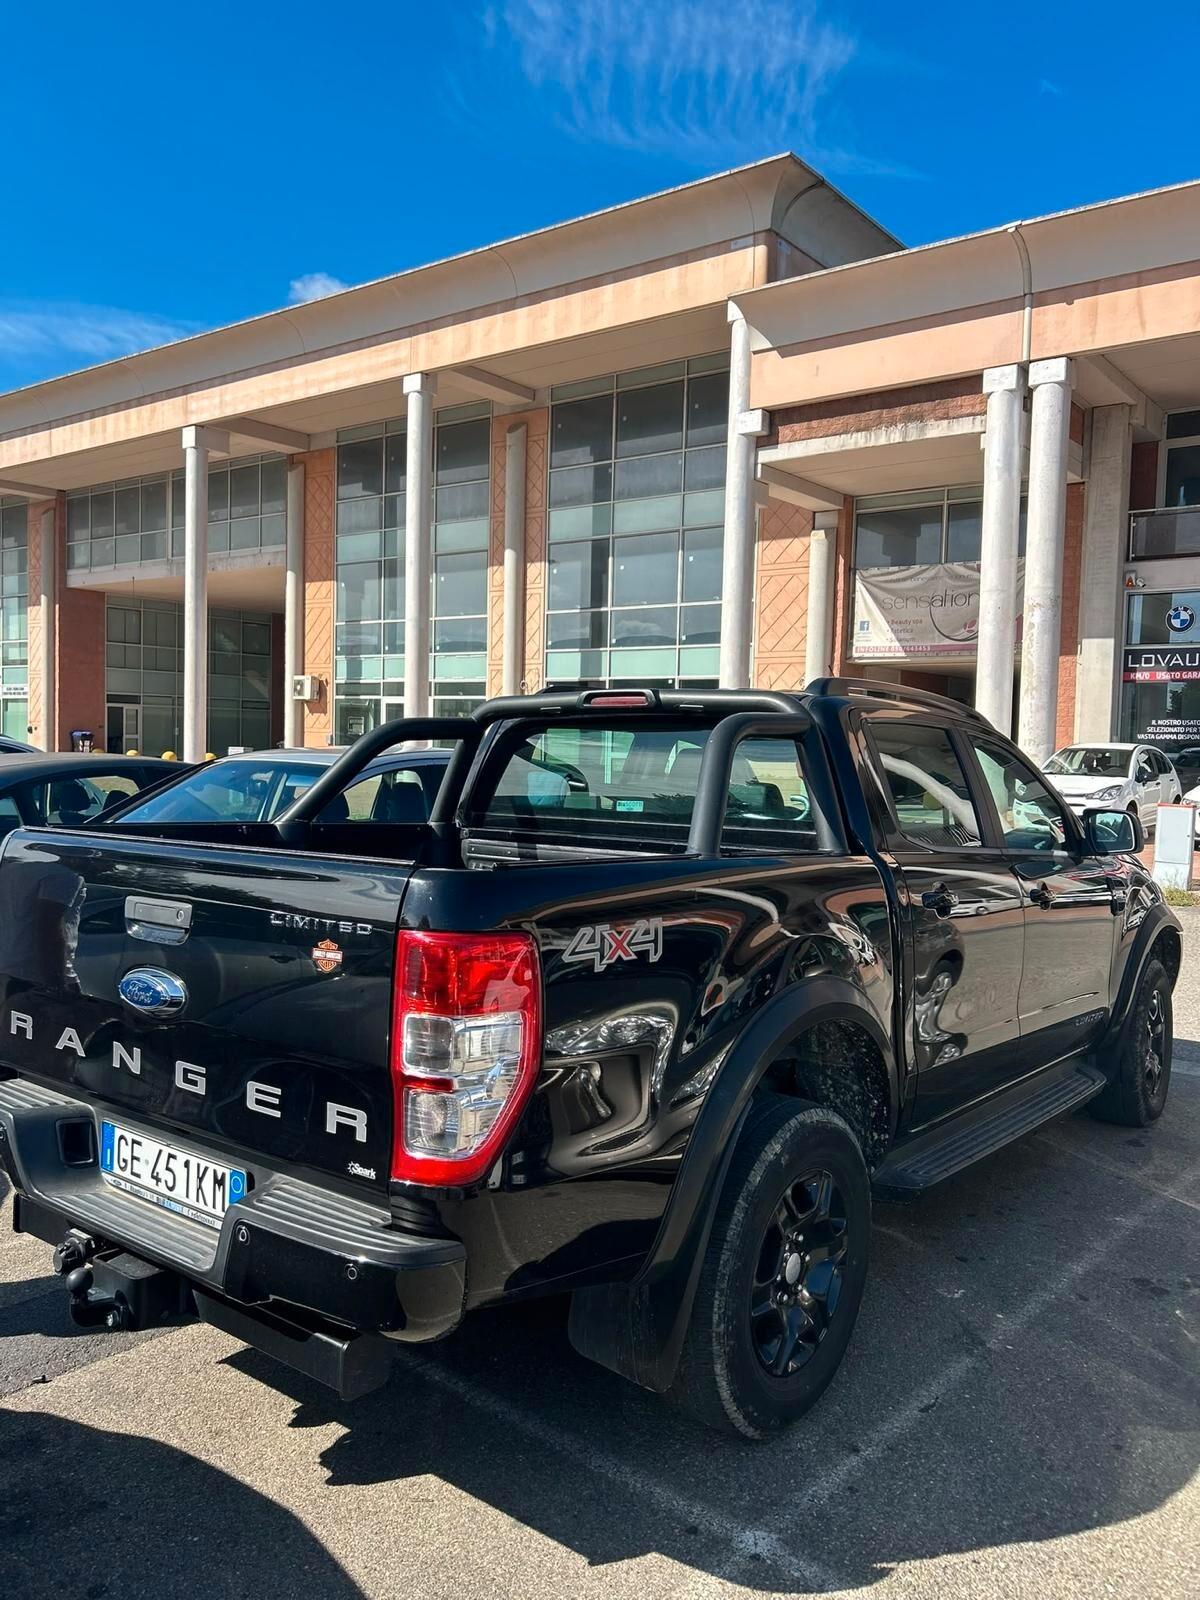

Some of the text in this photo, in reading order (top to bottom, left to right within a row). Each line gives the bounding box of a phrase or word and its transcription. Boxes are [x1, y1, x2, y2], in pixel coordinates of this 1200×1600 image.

[1128, 653, 1200, 667] LOVAU
[1130, 672, 1150, 680] KM/0
[1156, 671, 1181, 679] USATO
[269, 913, 373, 935] LIMITED
[126, 981, 154, 1003] Ford
[10, 1010, 367, 1143] RANGER
[352, 1162, 376, 1180] Spark
